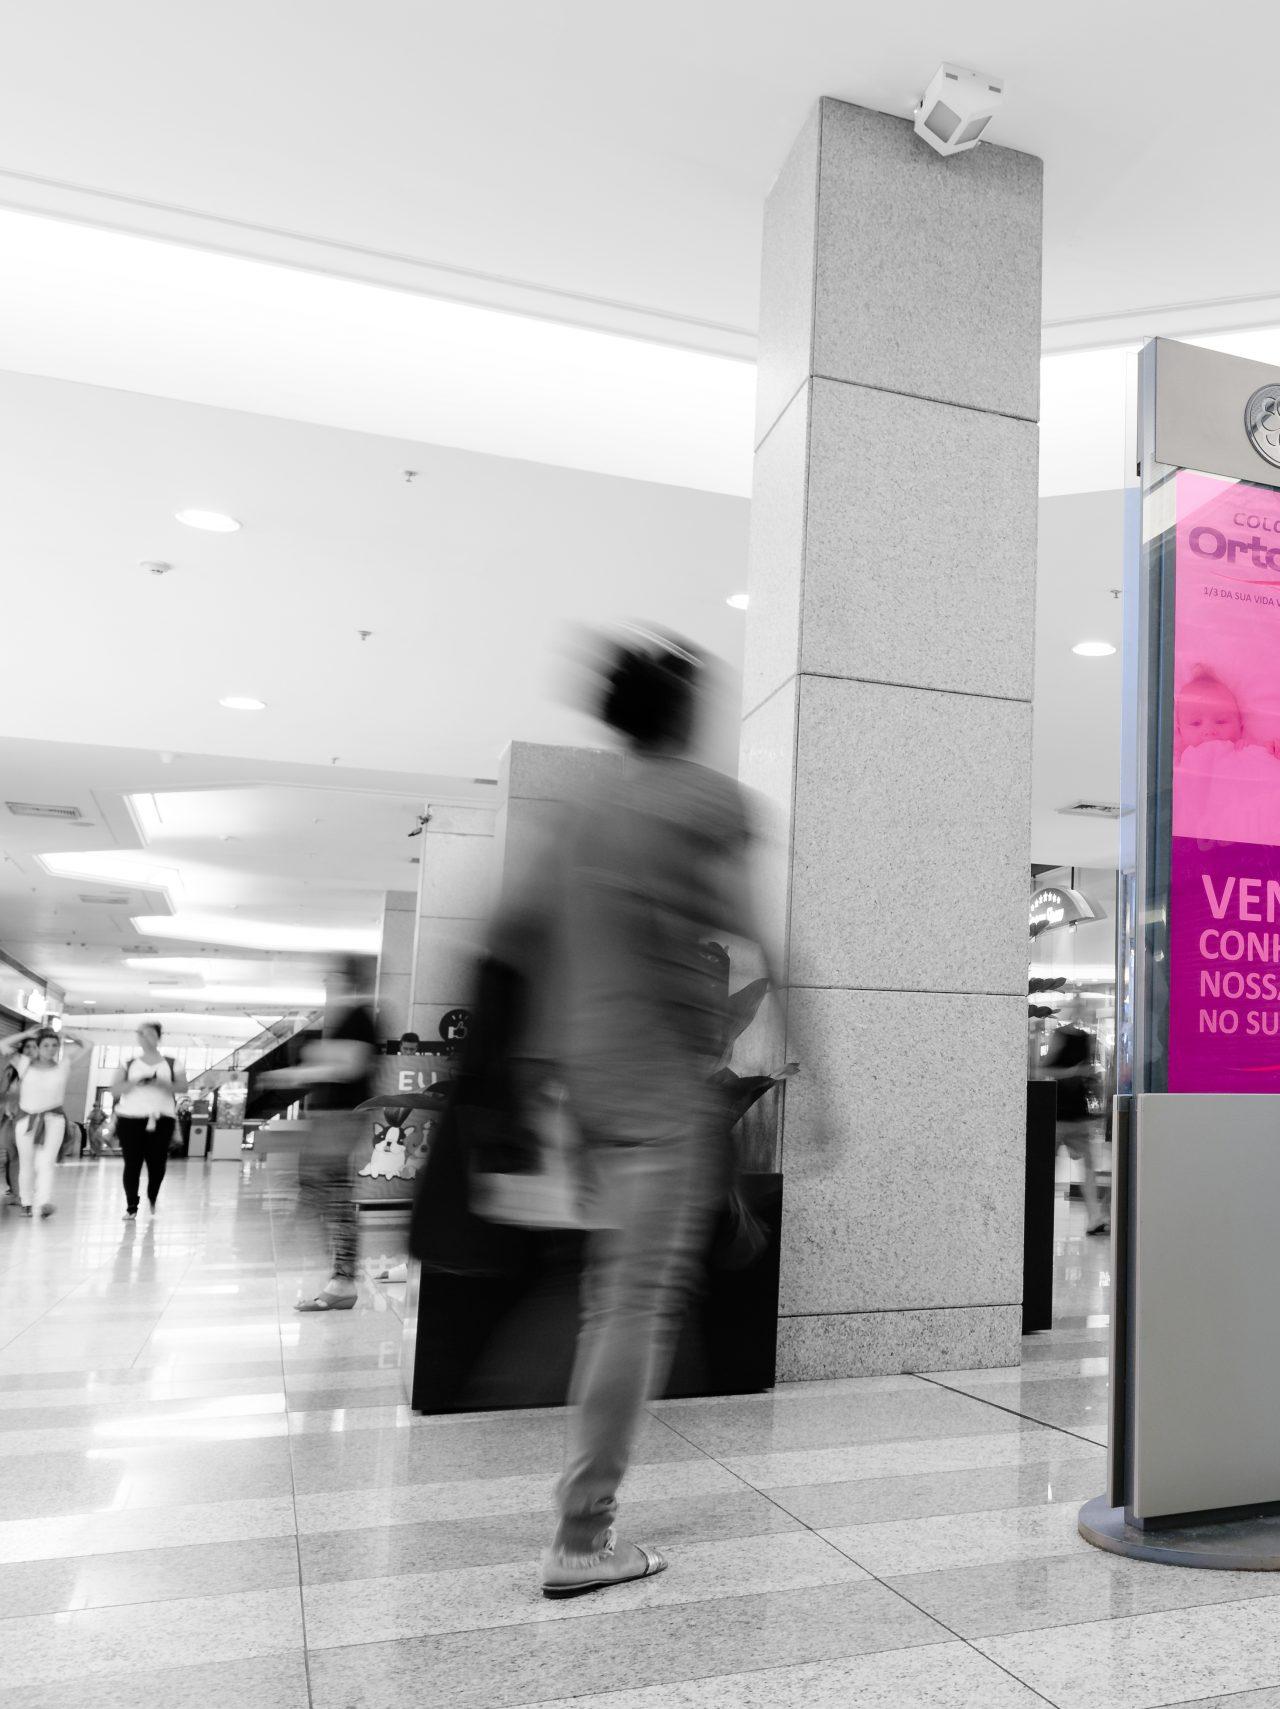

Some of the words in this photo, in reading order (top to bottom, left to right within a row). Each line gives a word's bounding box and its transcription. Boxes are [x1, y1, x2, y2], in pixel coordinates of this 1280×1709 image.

[1203, 586, 1218, 598] 1/3
[1220, 589, 1233, 599] DA
[1234, 592, 1252, 602] SUA
[1254, 595, 1274, 606] VIDA
[1199, 1008, 1239, 1034] NO
